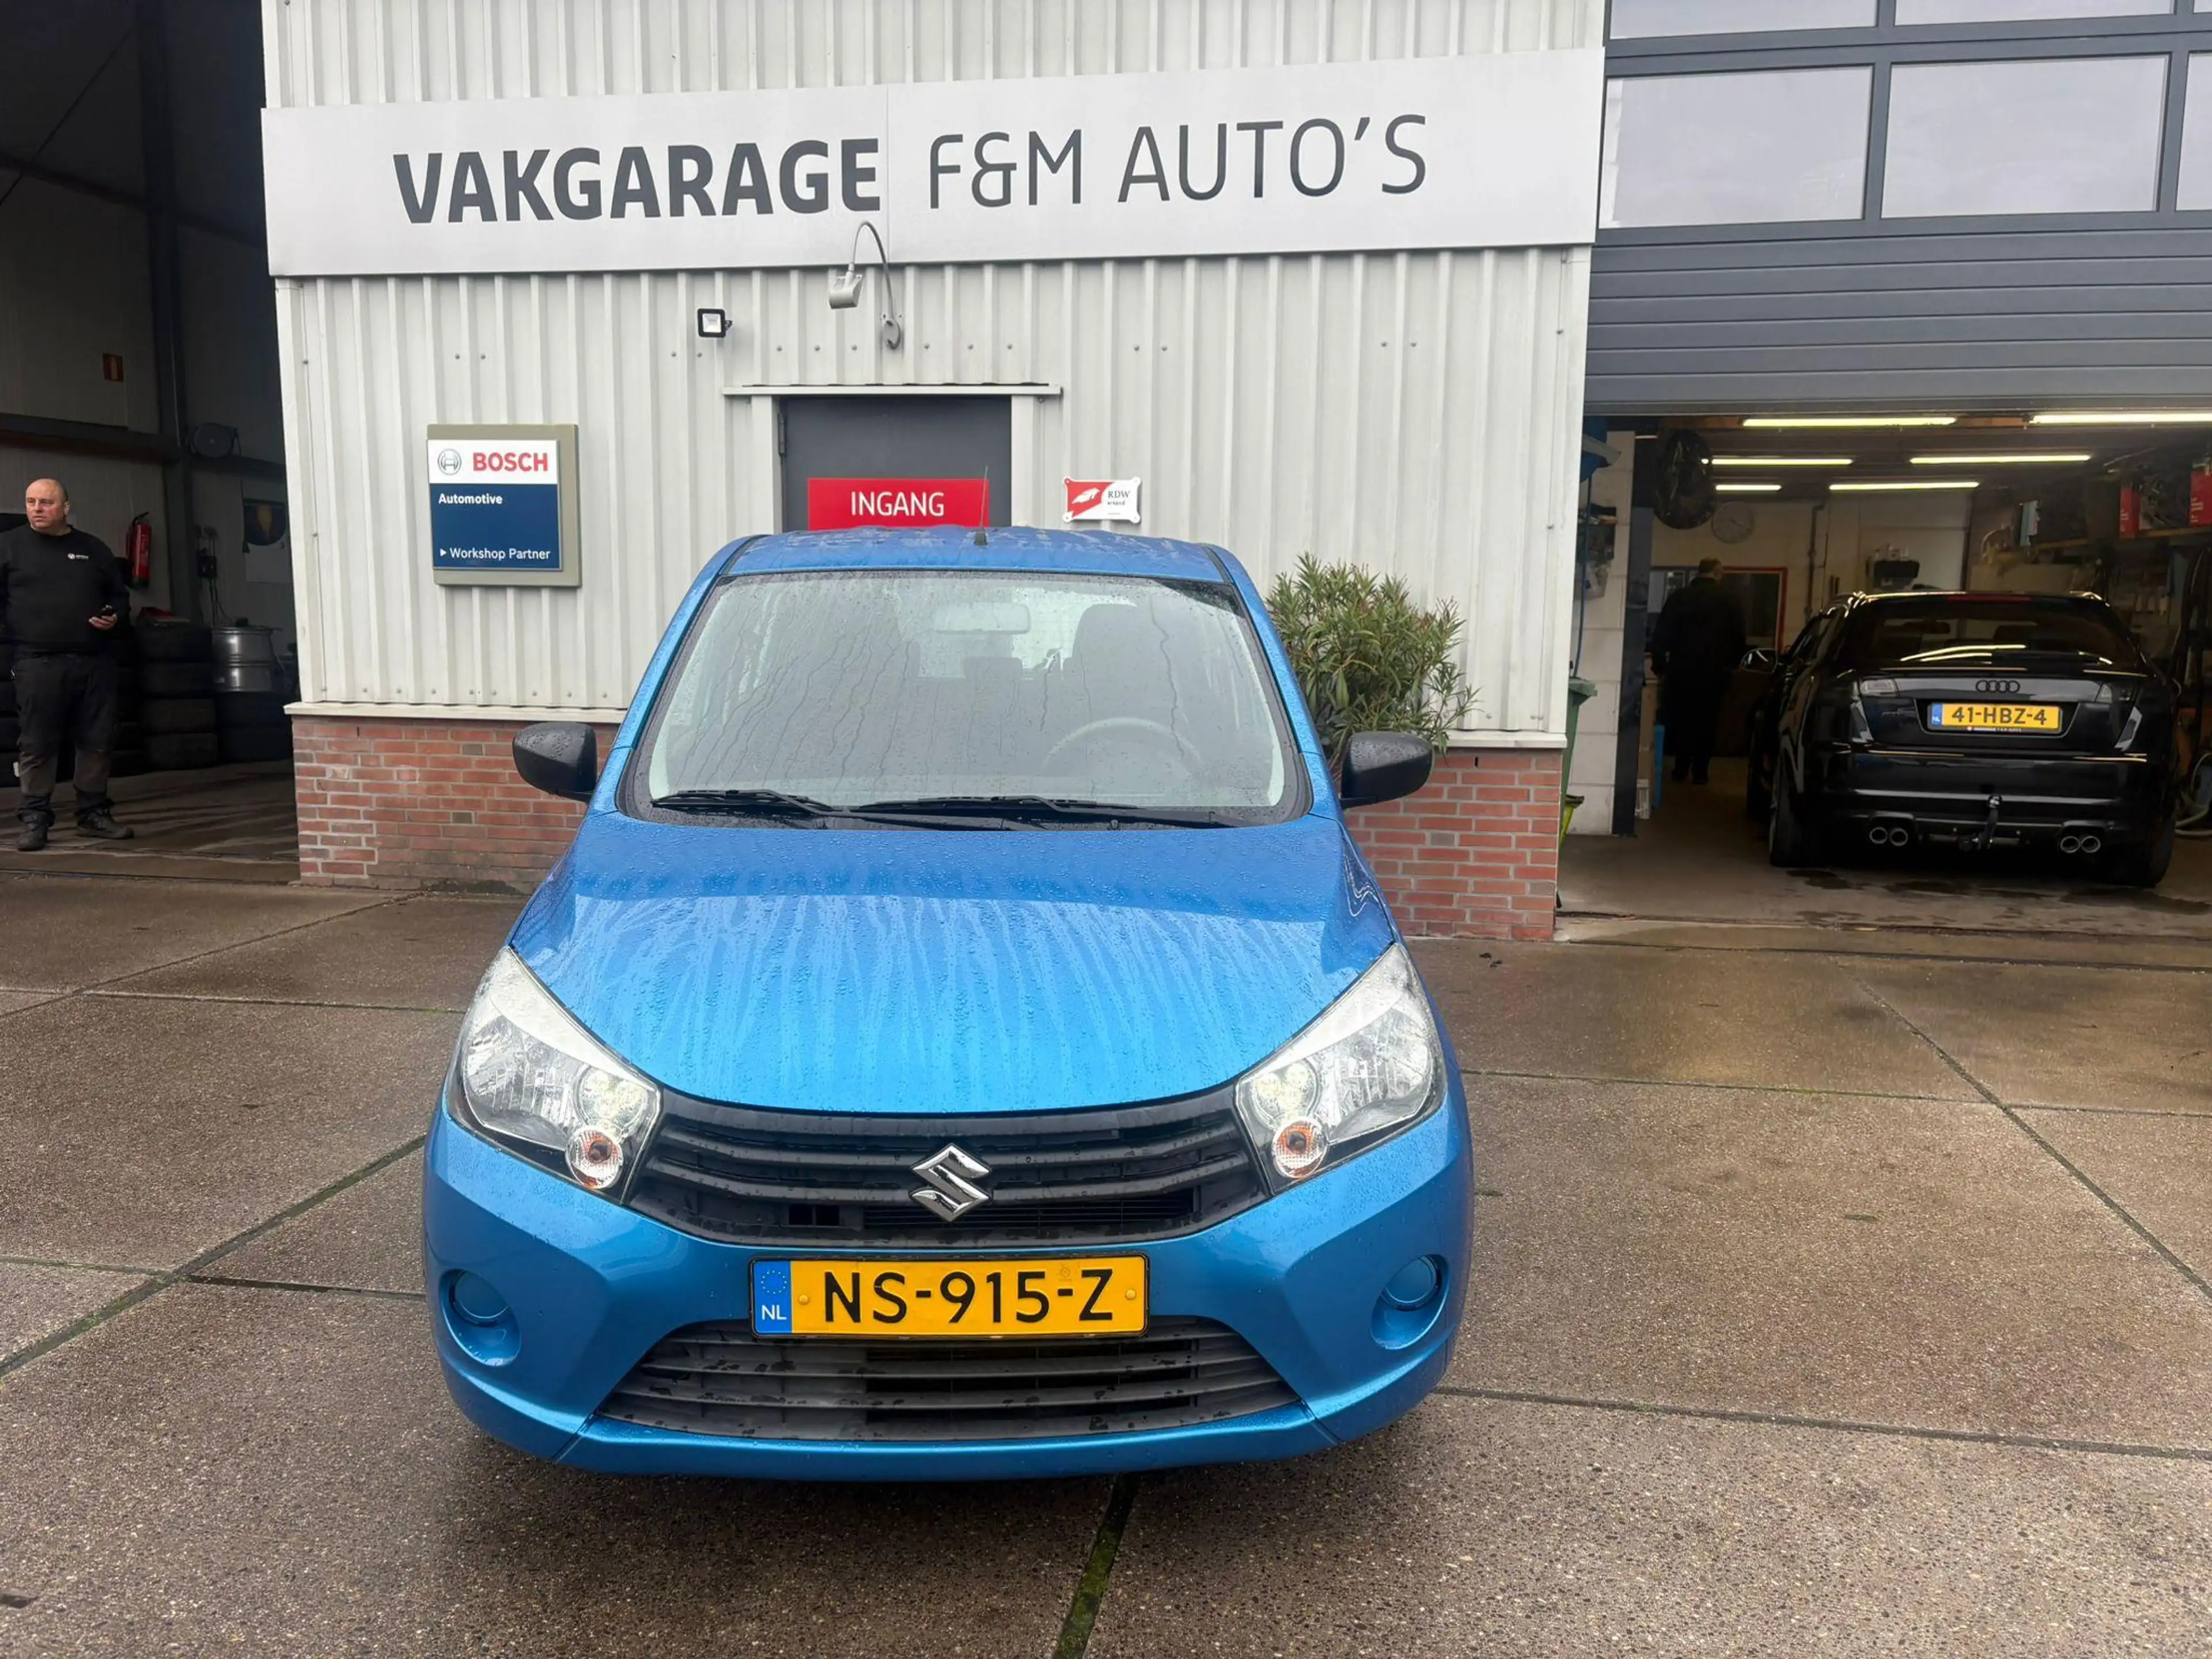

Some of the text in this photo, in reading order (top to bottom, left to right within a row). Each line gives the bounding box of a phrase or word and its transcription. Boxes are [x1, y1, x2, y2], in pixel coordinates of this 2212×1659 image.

[393, 113, 1426, 224] VAKGARAGE F&M AUTO'S
[472, 452, 548, 472] BOSCH
[438, 493, 503, 505] Automotive
[850, 491, 945, 517] INGANG
[449, 547, 551, 562] Workshop Partner
[1952, 706, 2047, 726] 41-HBZ-4
[761, 1268, 1113, 1324] NL NS-915-Z
